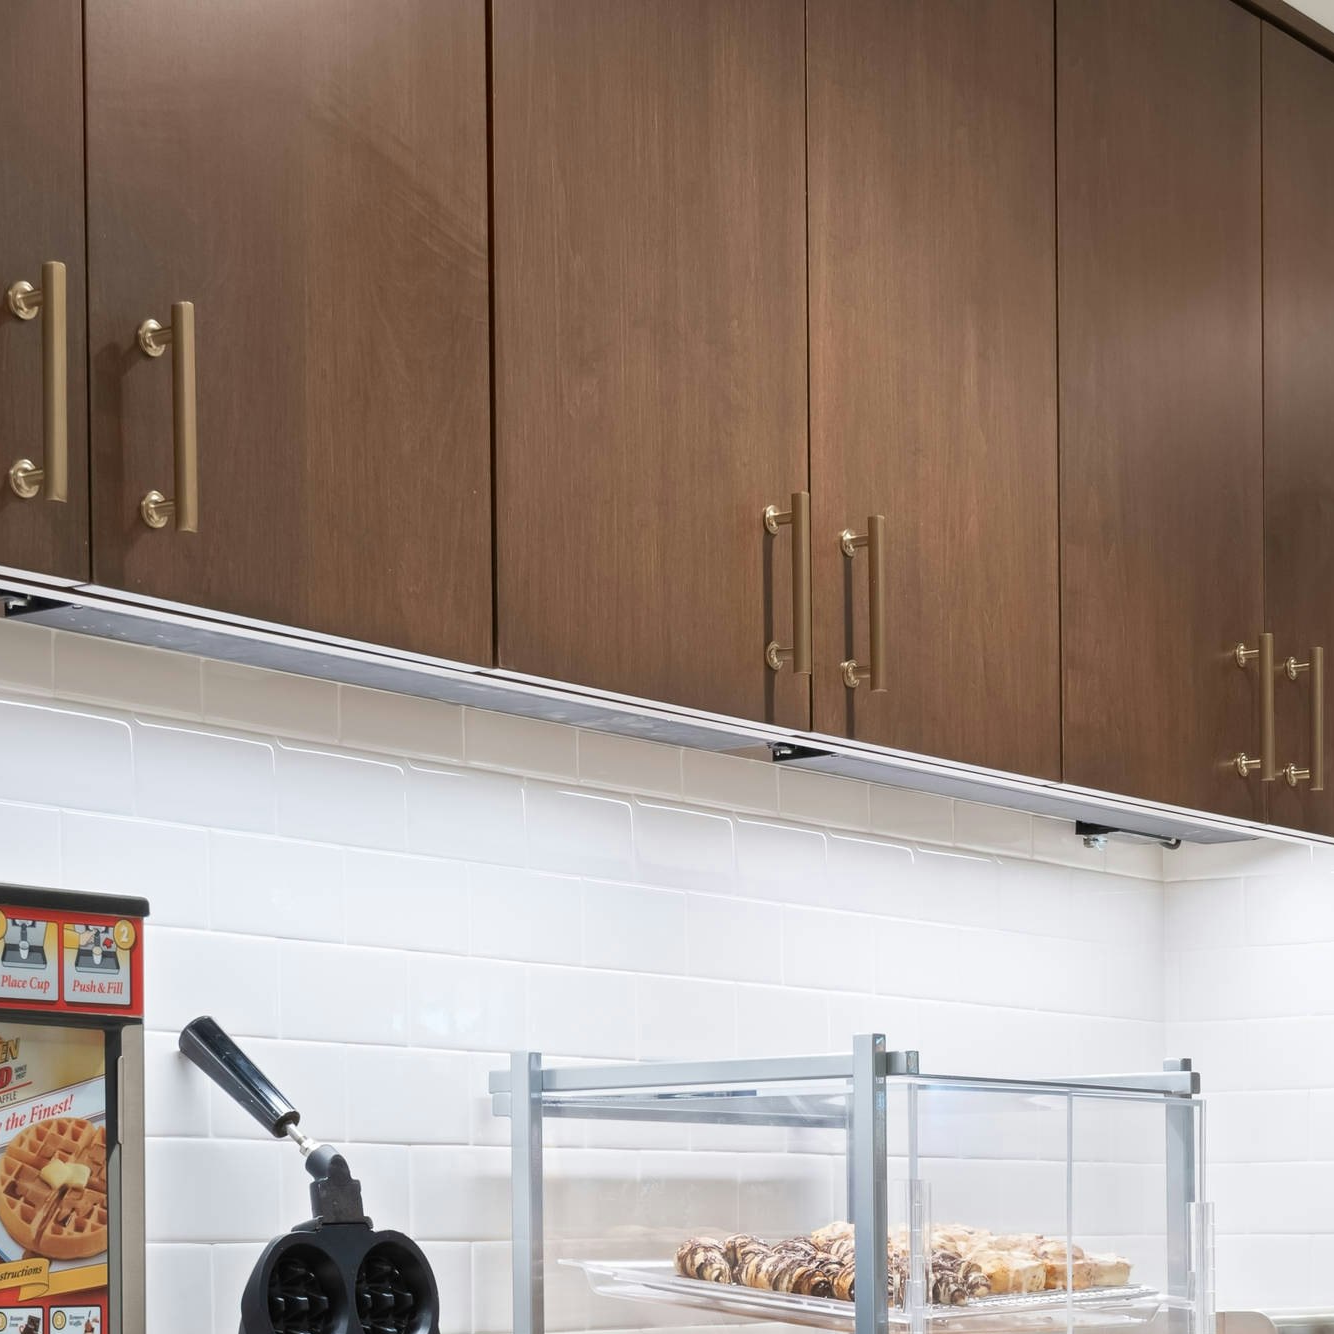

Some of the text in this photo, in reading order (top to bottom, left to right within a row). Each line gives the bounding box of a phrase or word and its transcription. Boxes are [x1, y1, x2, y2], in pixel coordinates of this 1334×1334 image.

[121, 926, 130, 943] 2
[1, 974, 51, 993] Place Cup
[72, 979, 124, 995] Push & Fill
[5, 1112, 26, 1132] the
[30, 1094, 75, 1123] Finest!
